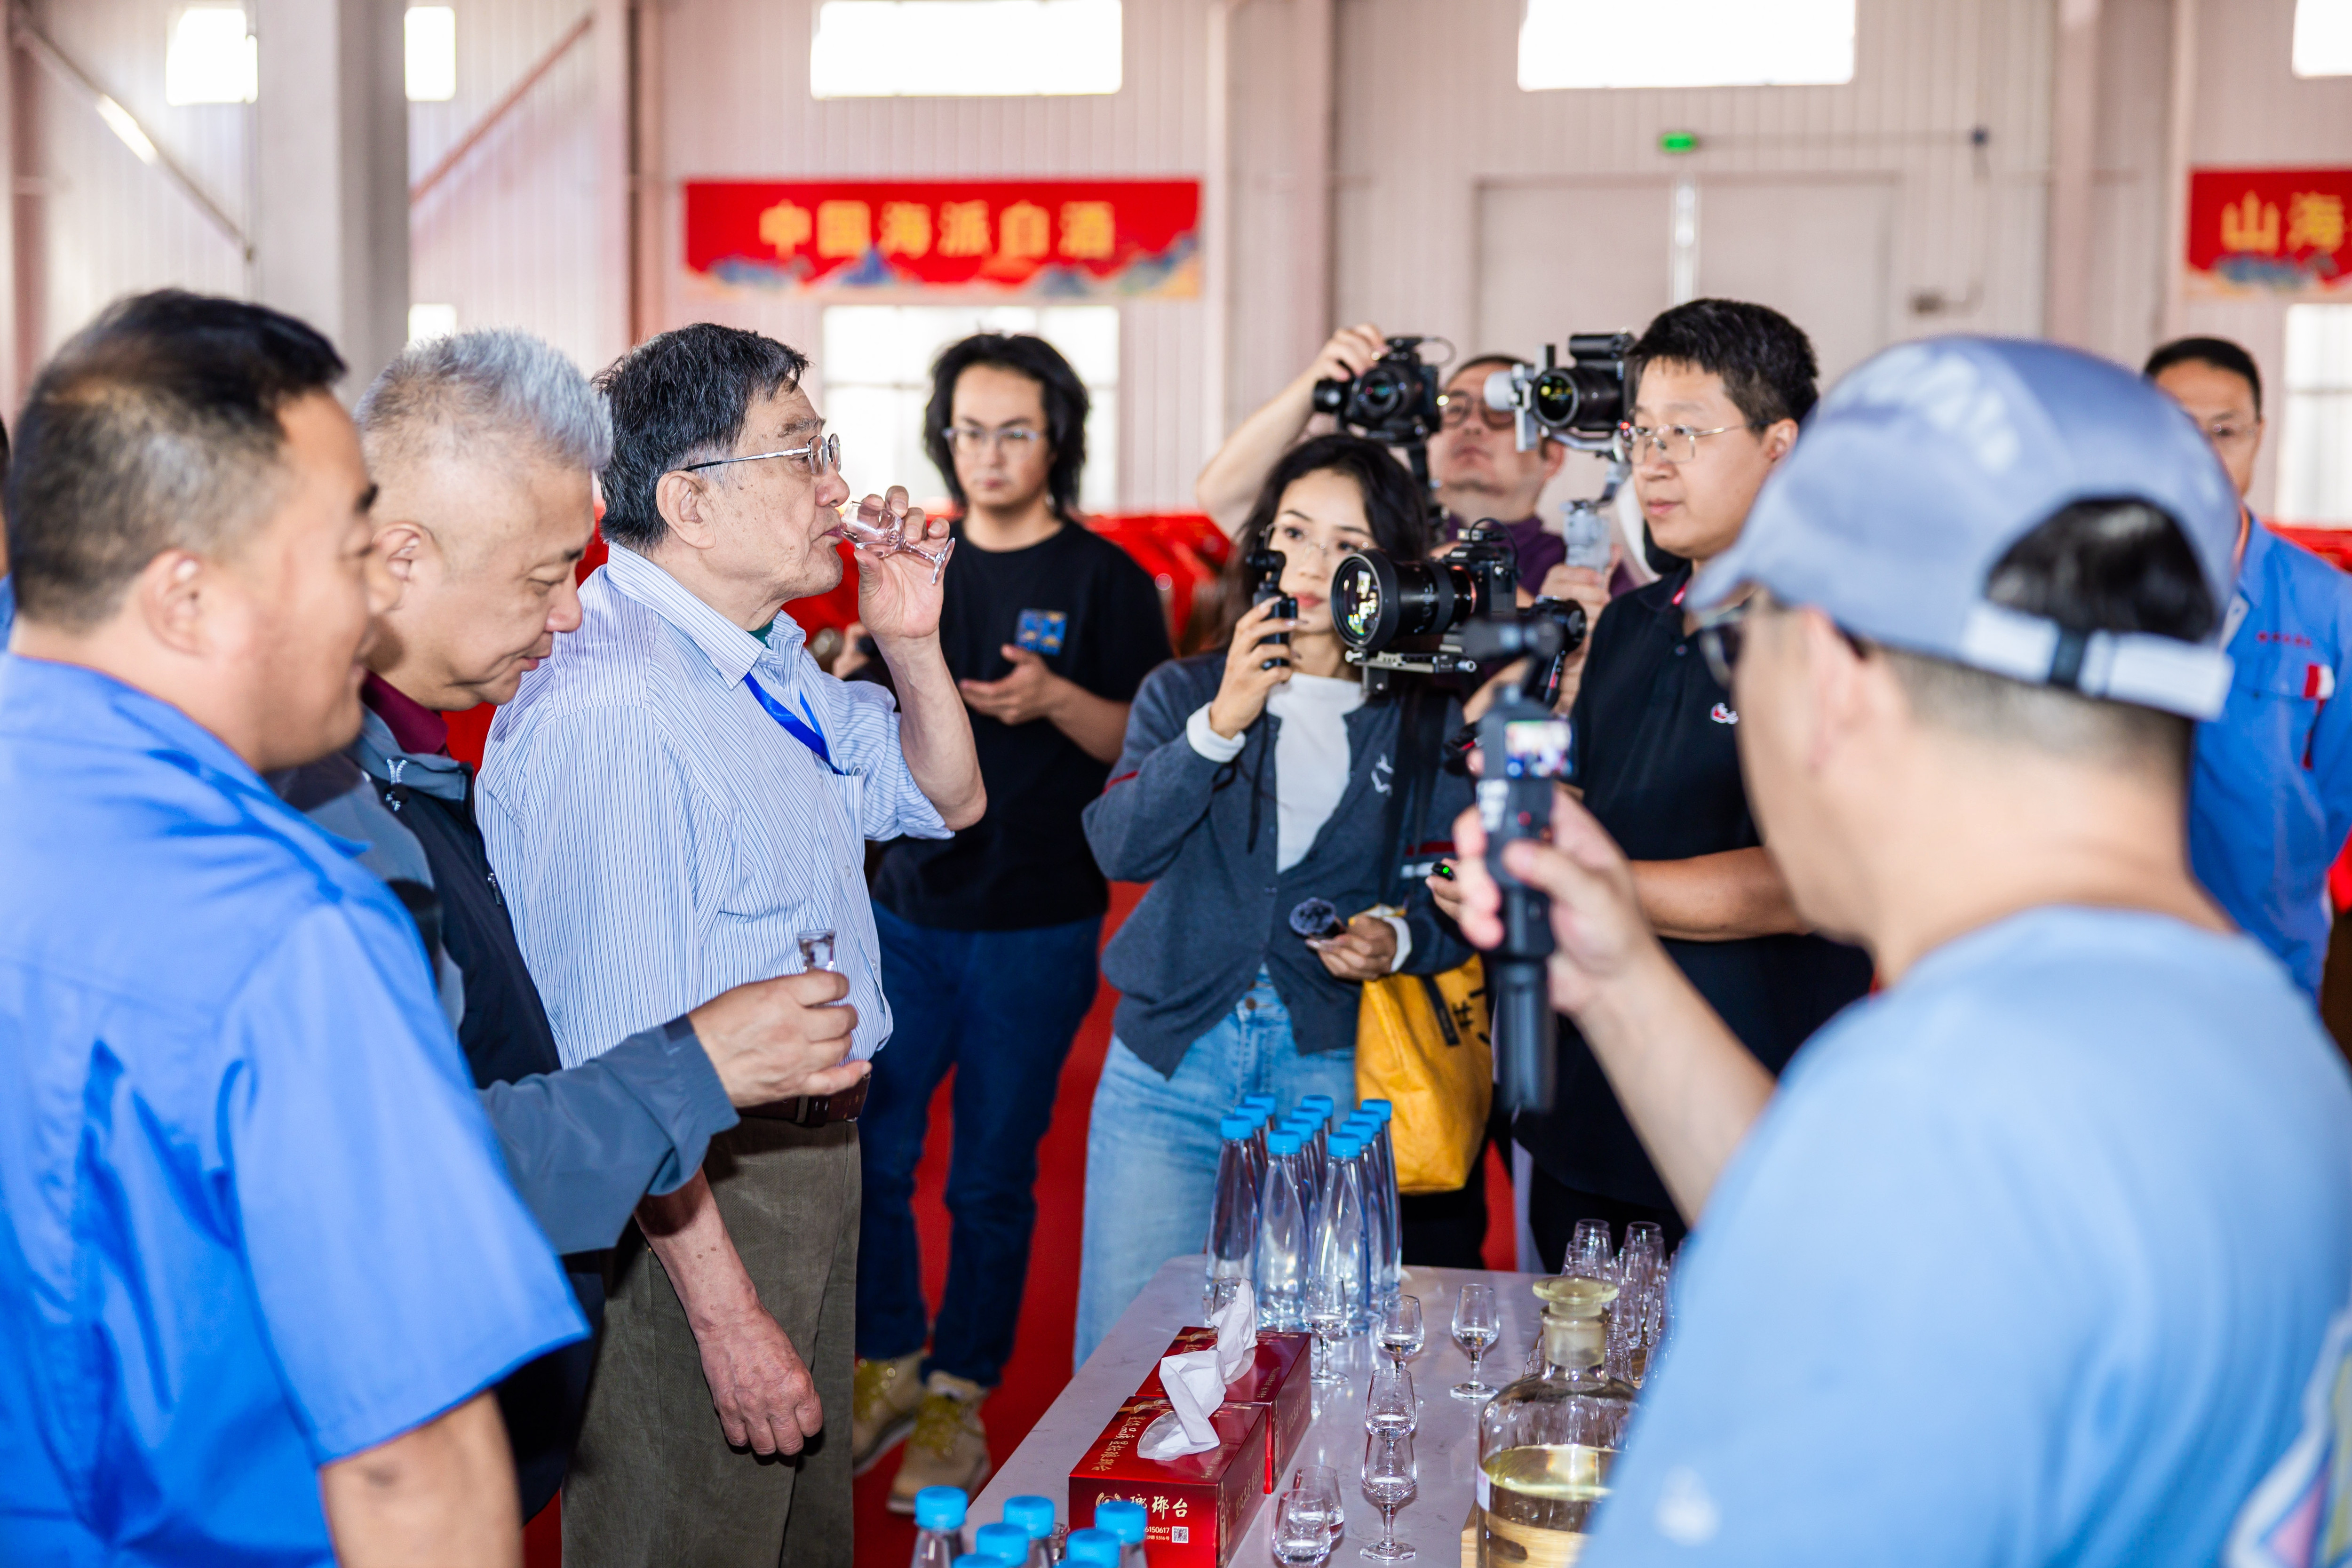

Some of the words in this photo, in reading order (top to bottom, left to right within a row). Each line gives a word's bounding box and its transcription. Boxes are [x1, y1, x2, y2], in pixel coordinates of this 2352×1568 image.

[758, 199, 1116, 260] 中国海派白酒
[2220, 189, 2352, 255] 山海
